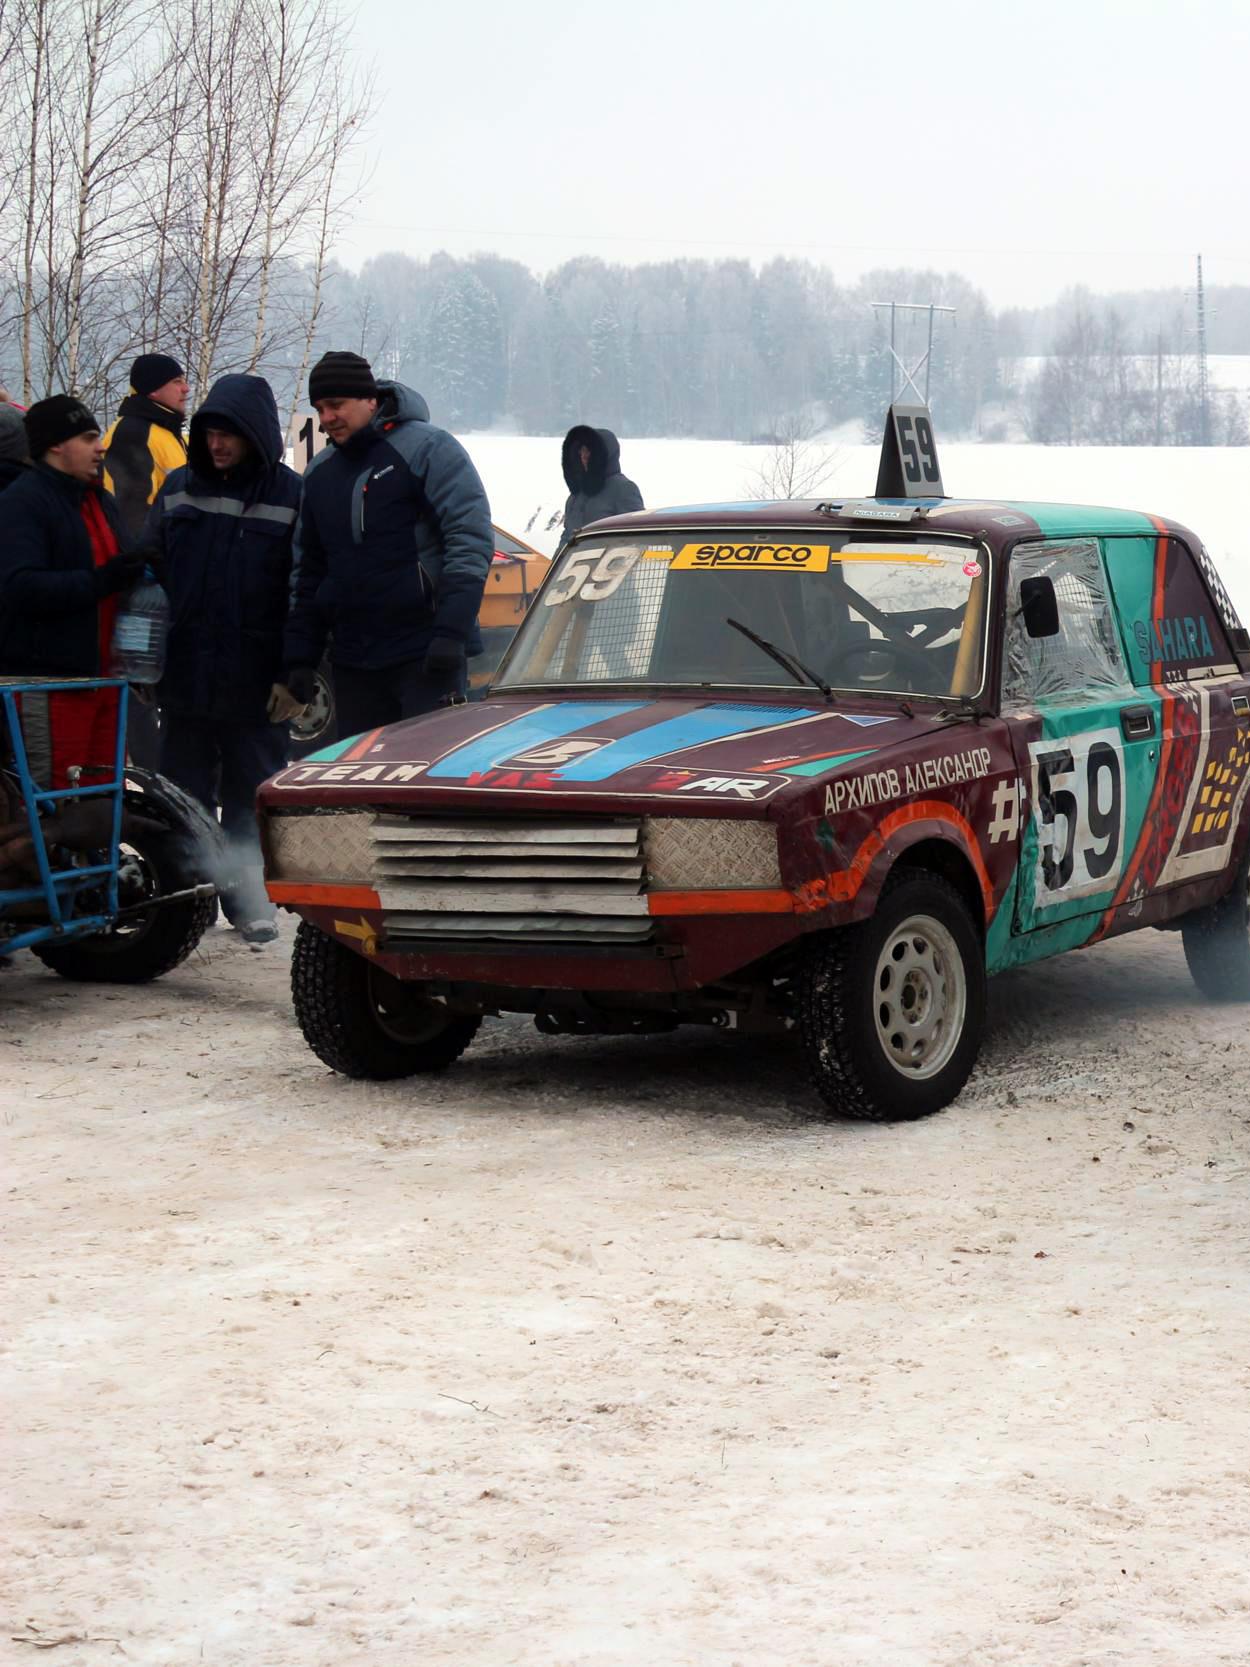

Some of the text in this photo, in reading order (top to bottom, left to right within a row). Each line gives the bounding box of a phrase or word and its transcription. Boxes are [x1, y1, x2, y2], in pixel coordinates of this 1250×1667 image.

[896, 415, 940, 483] 59
[545, 545, 642, 607] 59
[695, 544, 812, 566] sparco
[1133, 615, 1216, 665] SAHARA
[293, 764, 430, 782] TEAM
[677, 776, 770, 799] AR
[824, 747, 992, 816] АРХИПОВ АЛЕКСАНДР
[1036, 741, 1122, 890] 59
